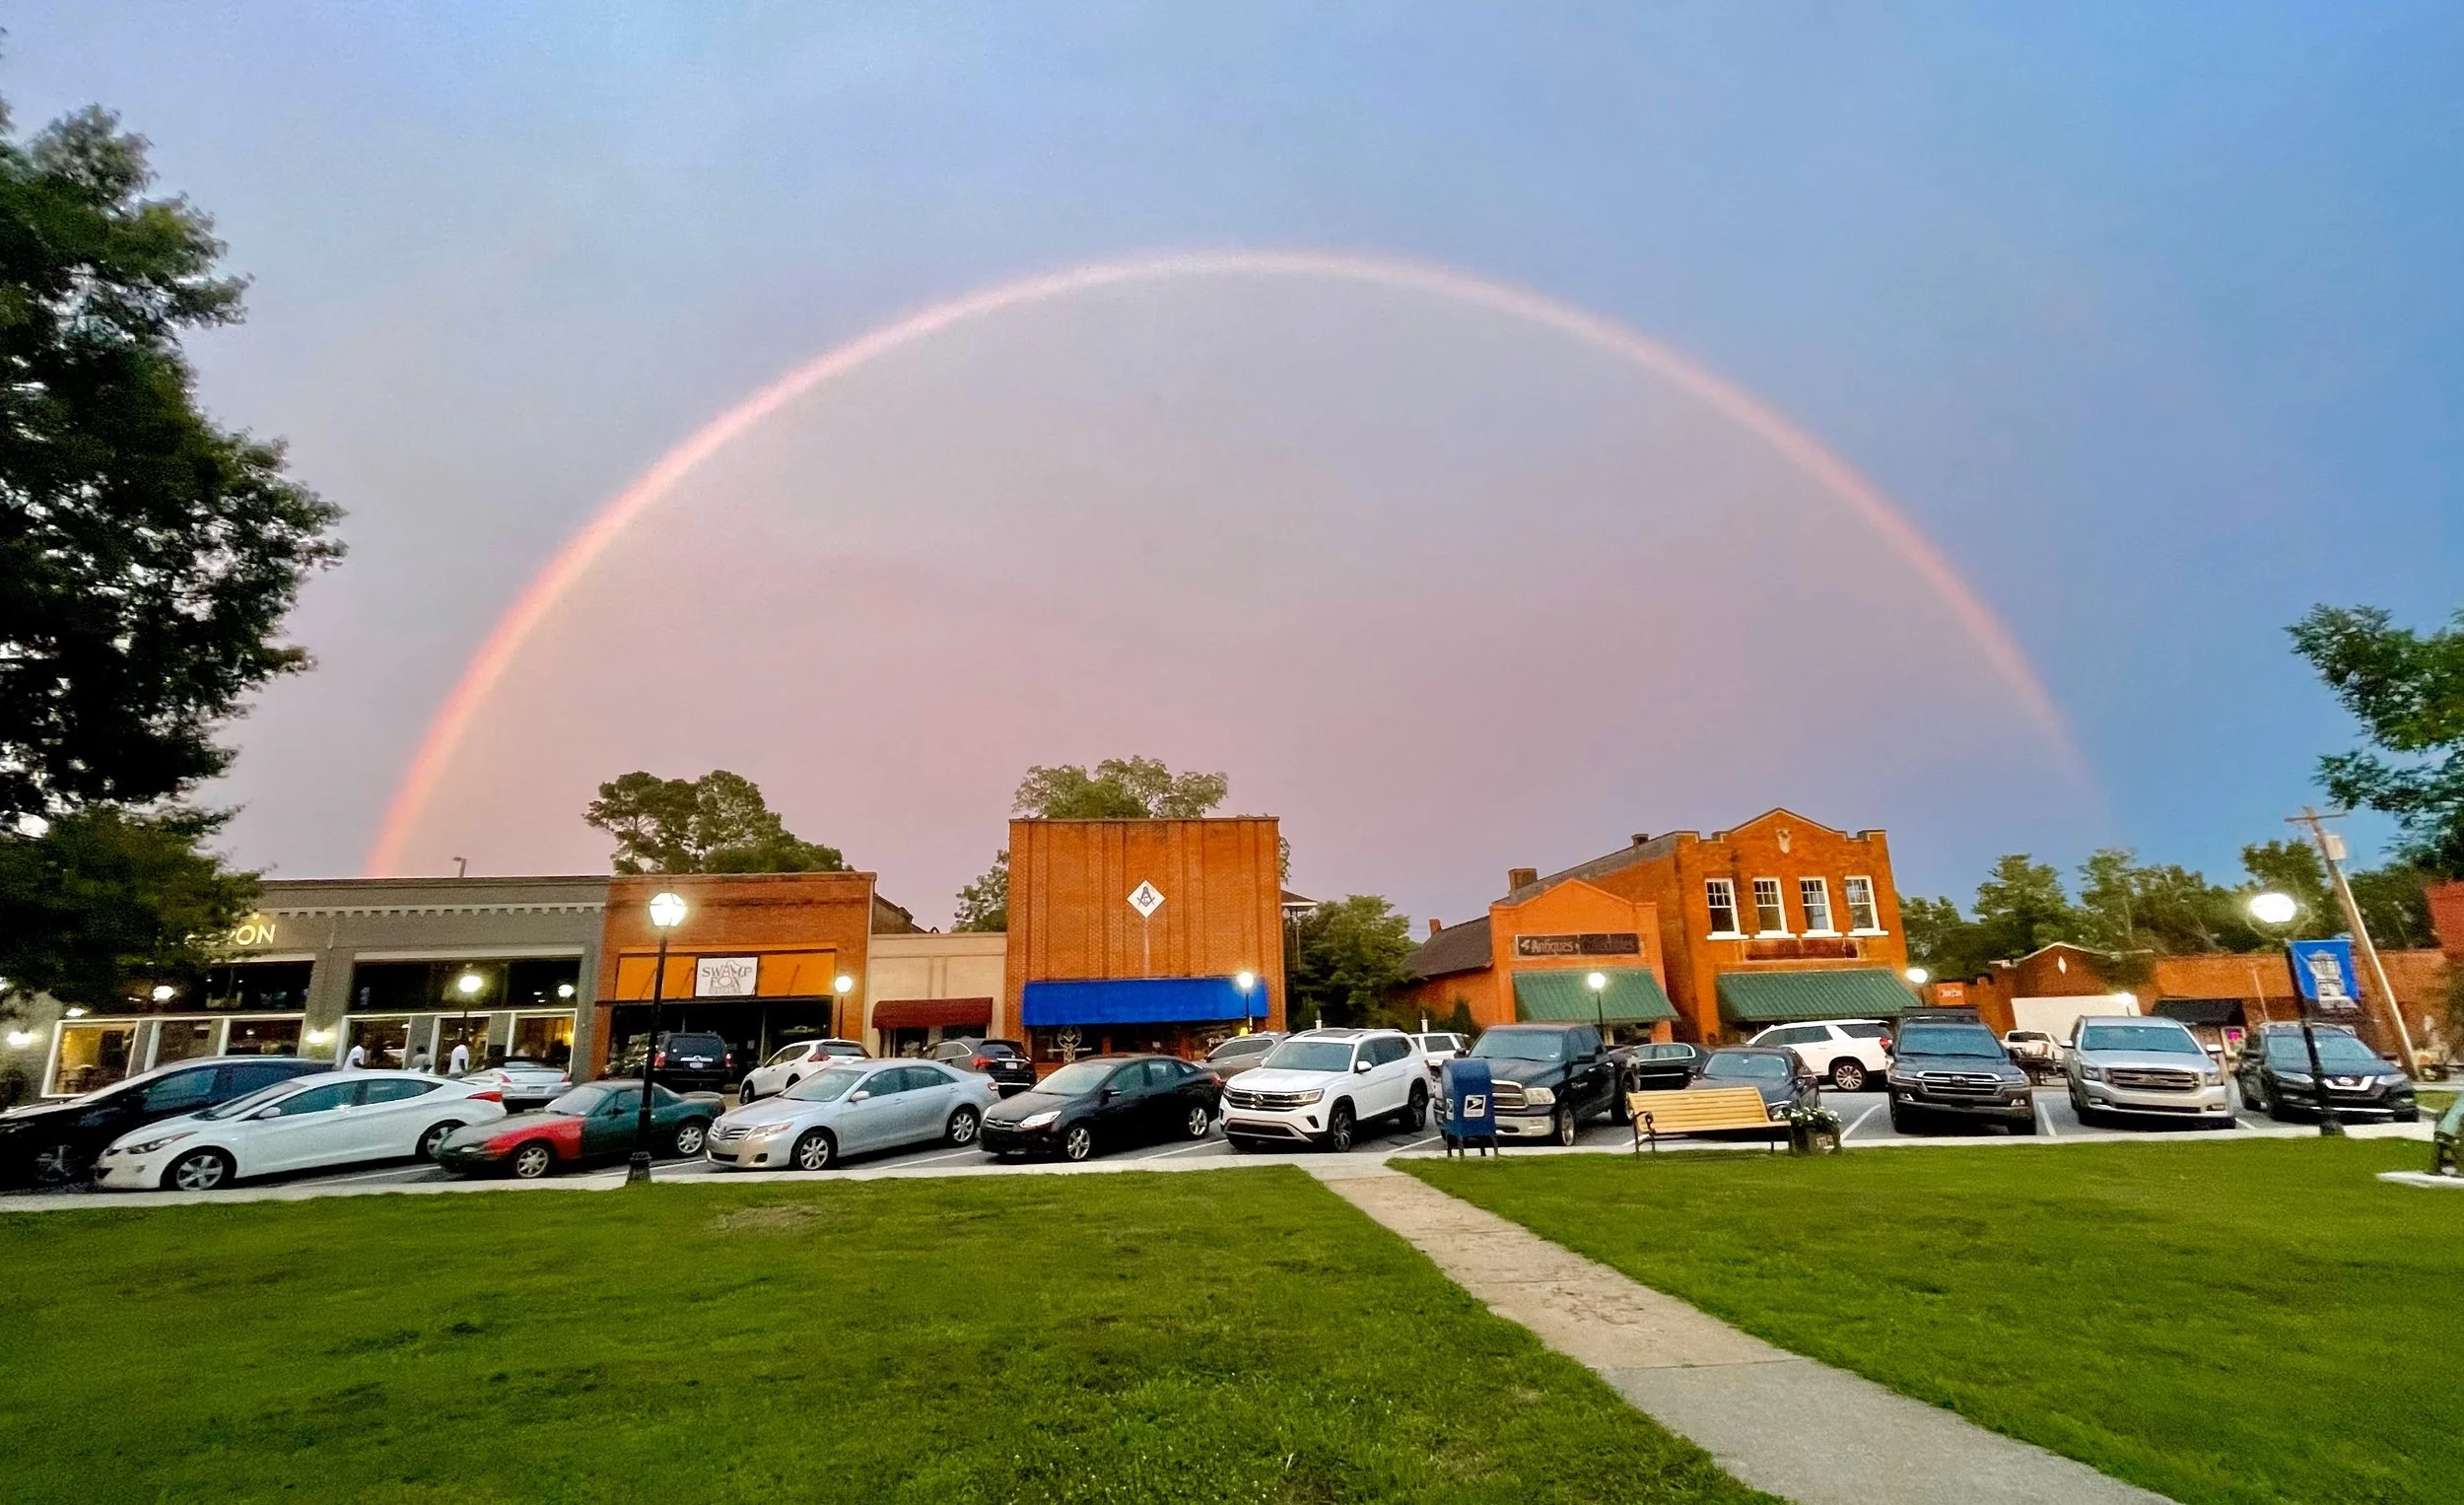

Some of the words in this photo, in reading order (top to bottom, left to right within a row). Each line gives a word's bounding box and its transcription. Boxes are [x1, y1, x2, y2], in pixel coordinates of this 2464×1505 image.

[1531, 938, 1574, 954] Antiques
[702, 965, 753, 977] SWAMP
[711, 976, 740, 987] FOX
